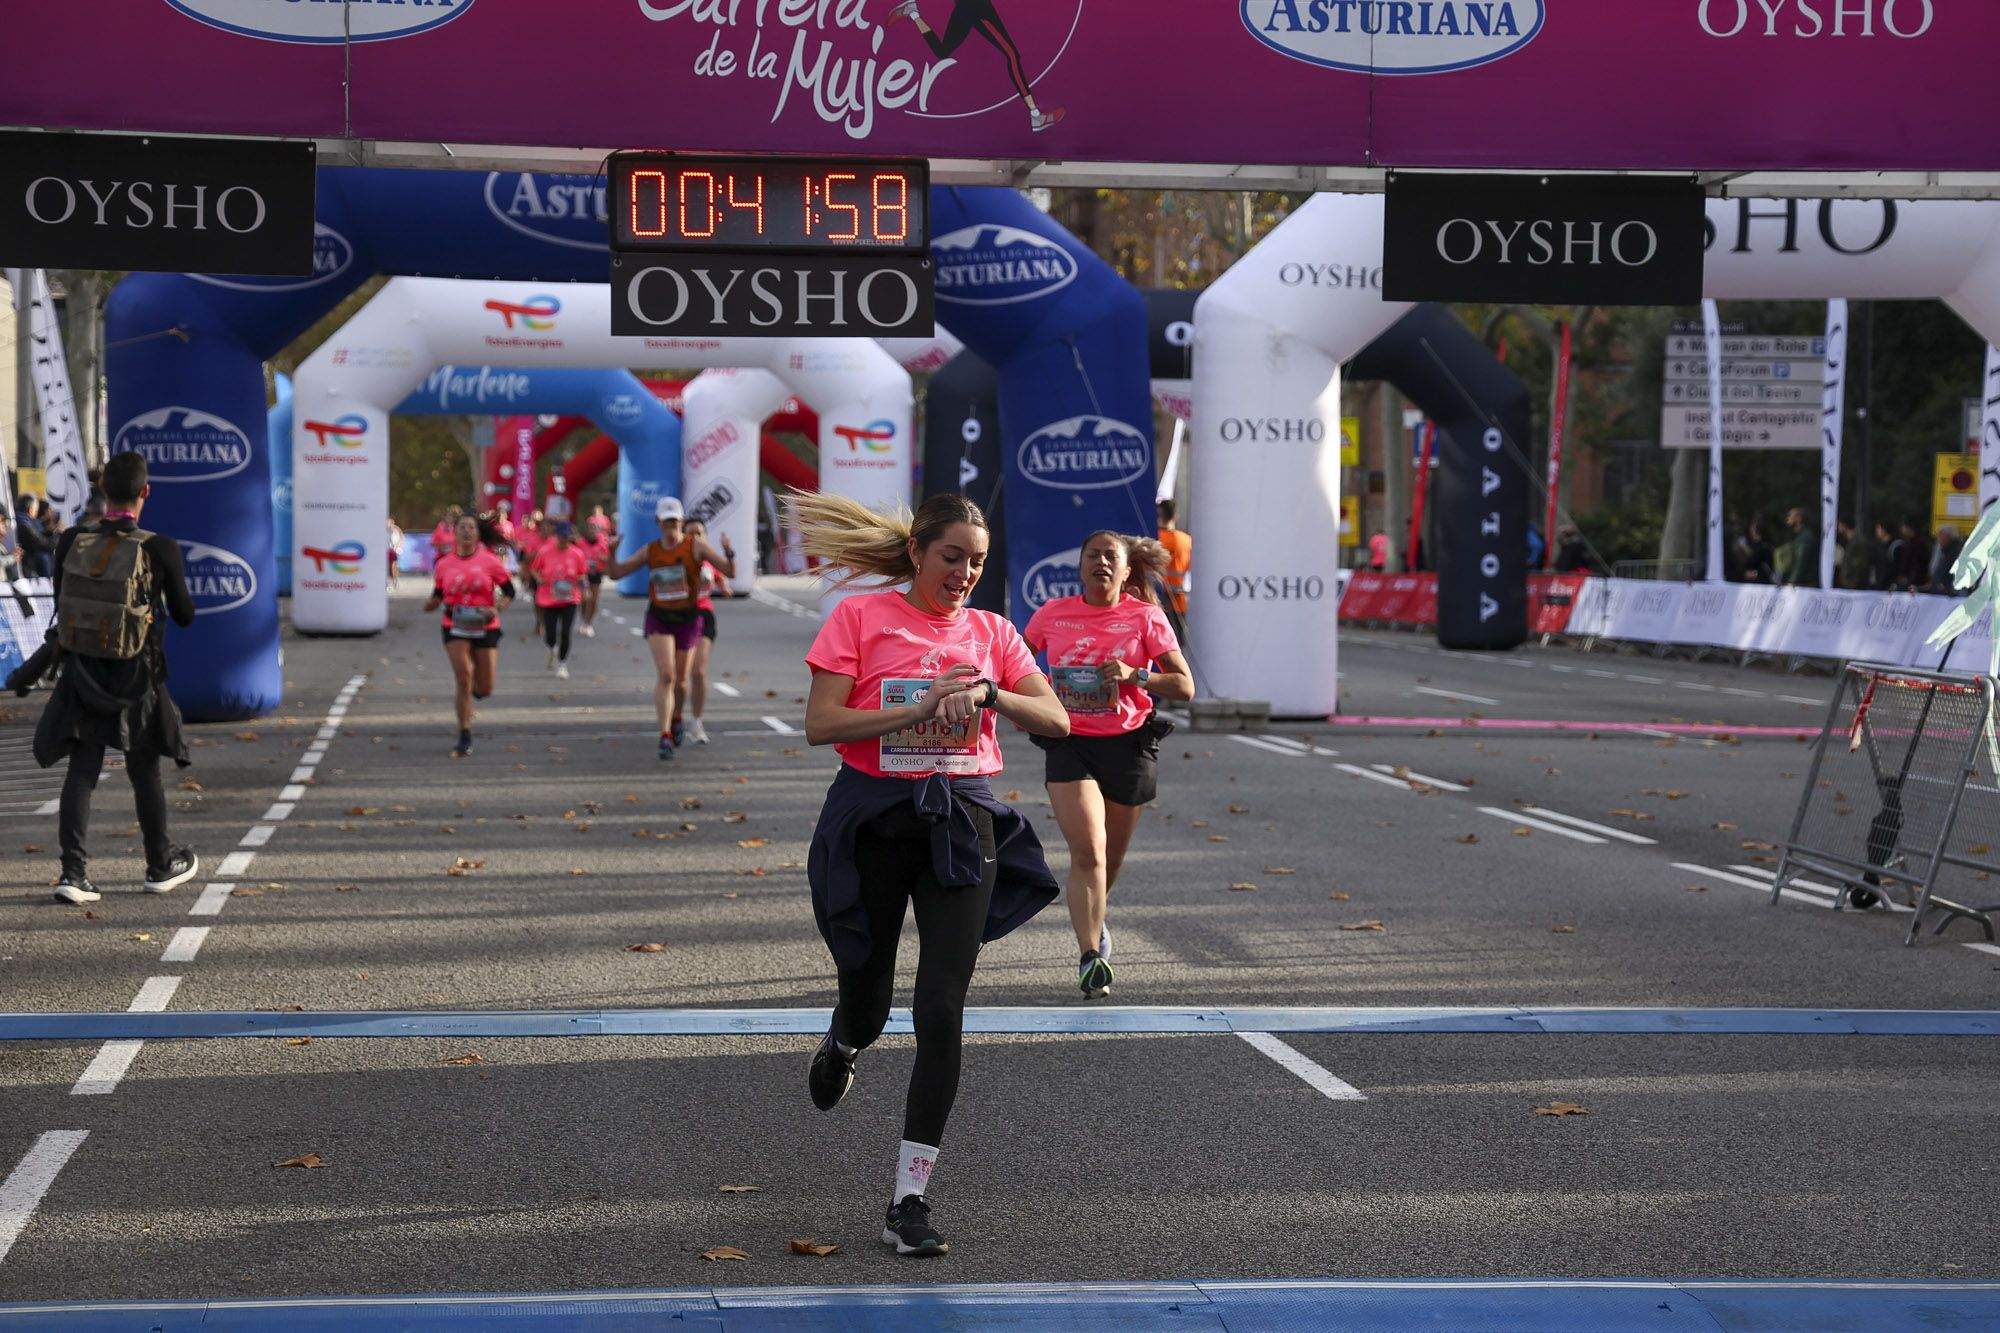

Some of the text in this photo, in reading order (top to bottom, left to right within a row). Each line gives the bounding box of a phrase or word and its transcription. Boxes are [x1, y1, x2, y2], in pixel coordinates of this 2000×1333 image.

[694, 25, 958, 139] de la Mujer
[25, 176, 266, 233] OYSHO
[1436, 218, 1658, 266] OYSHO
[627, 266, 918, 327] OYSHO
[935, 258, 1067, 287] STURIANA
[1220, 418, 1325, 443] OYSHO
[1480, 426, 1502, 624] VOLVO
[1218, 575, 1324, 601] OYSHO
[891, 758, 924, 766] OYSHO
